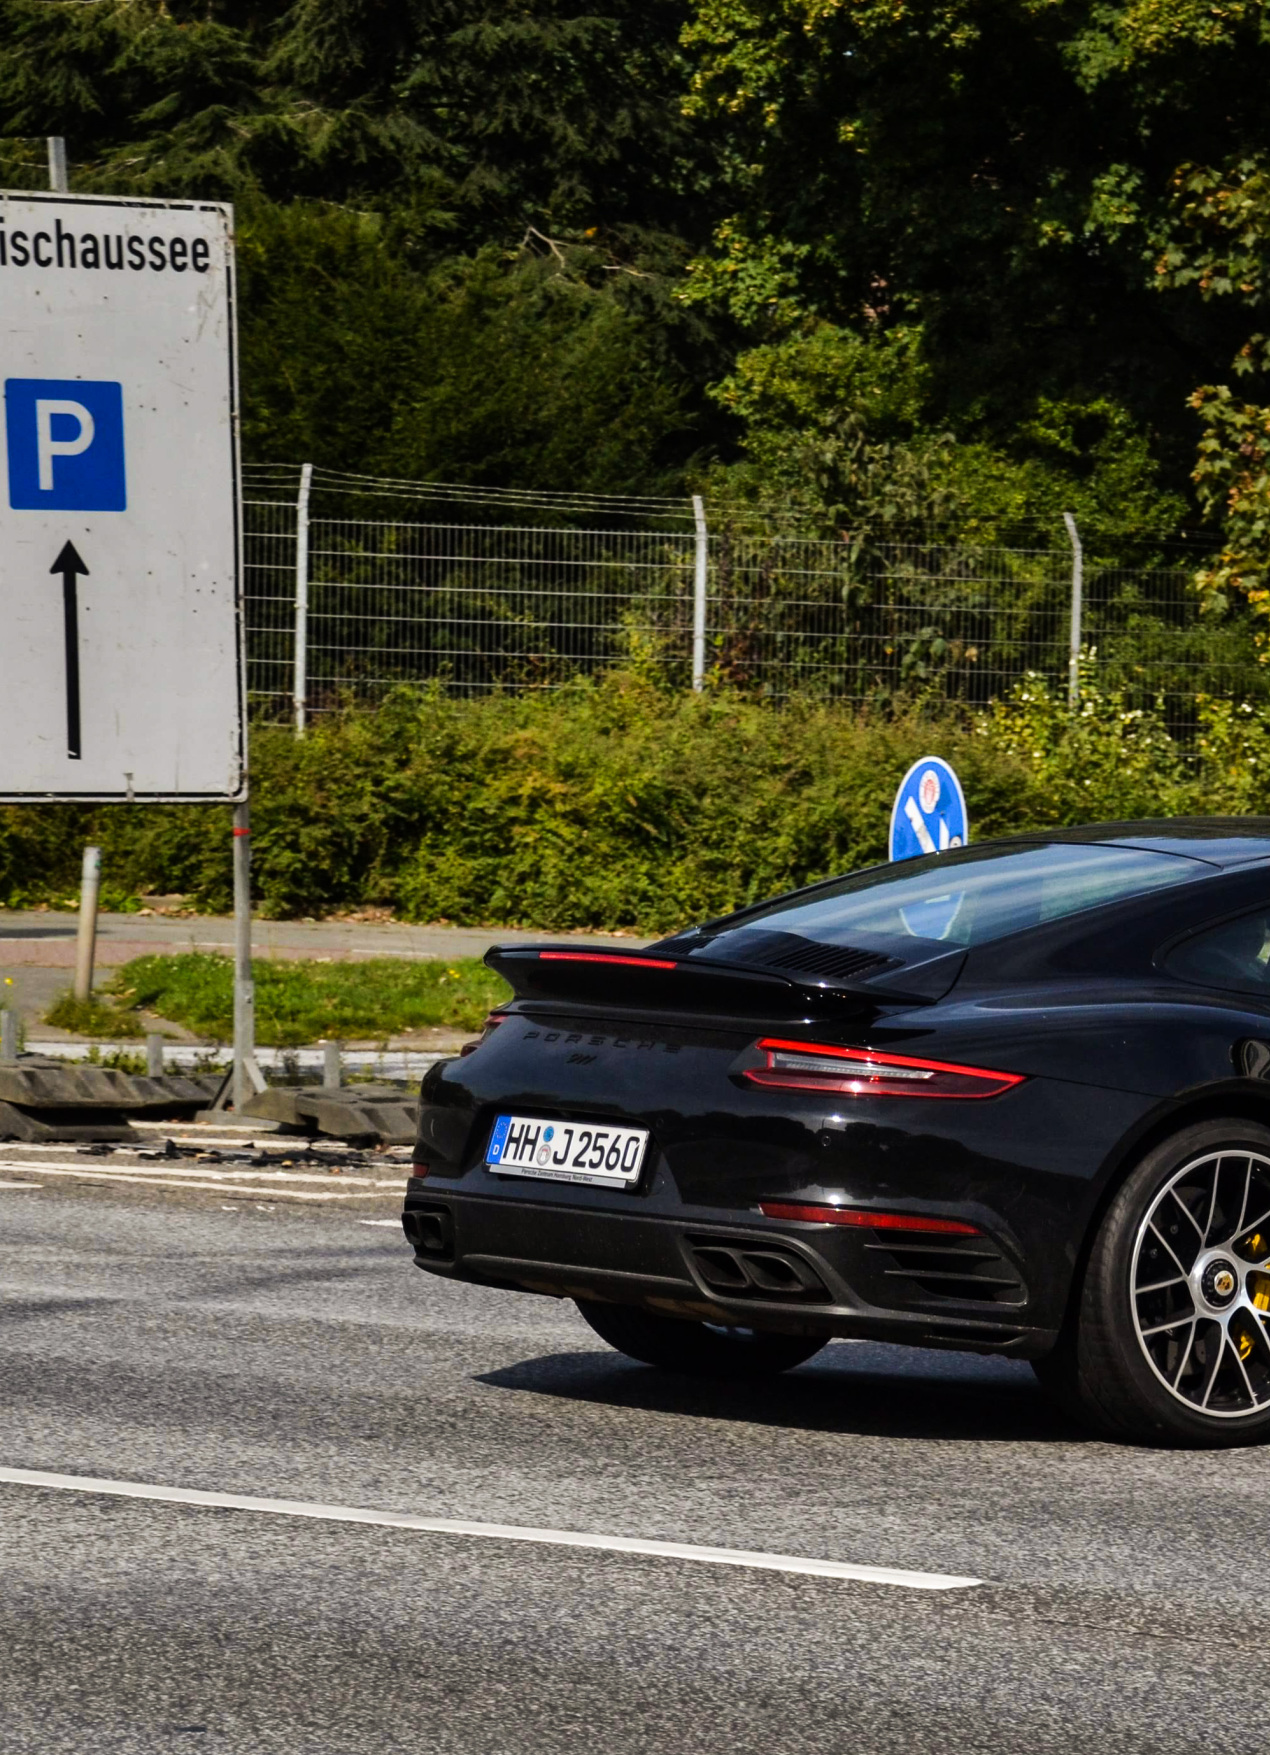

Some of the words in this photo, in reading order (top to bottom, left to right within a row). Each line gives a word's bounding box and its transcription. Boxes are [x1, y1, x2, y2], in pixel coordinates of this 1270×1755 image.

[0, 216, 210, 273] ischaussee
[35, 398, 96, 491] P
[522, 1031, 683, 1054] PORSCHE
[492, 1144, 500, 1155] D
[502, 1122, 541, 1162] HH
